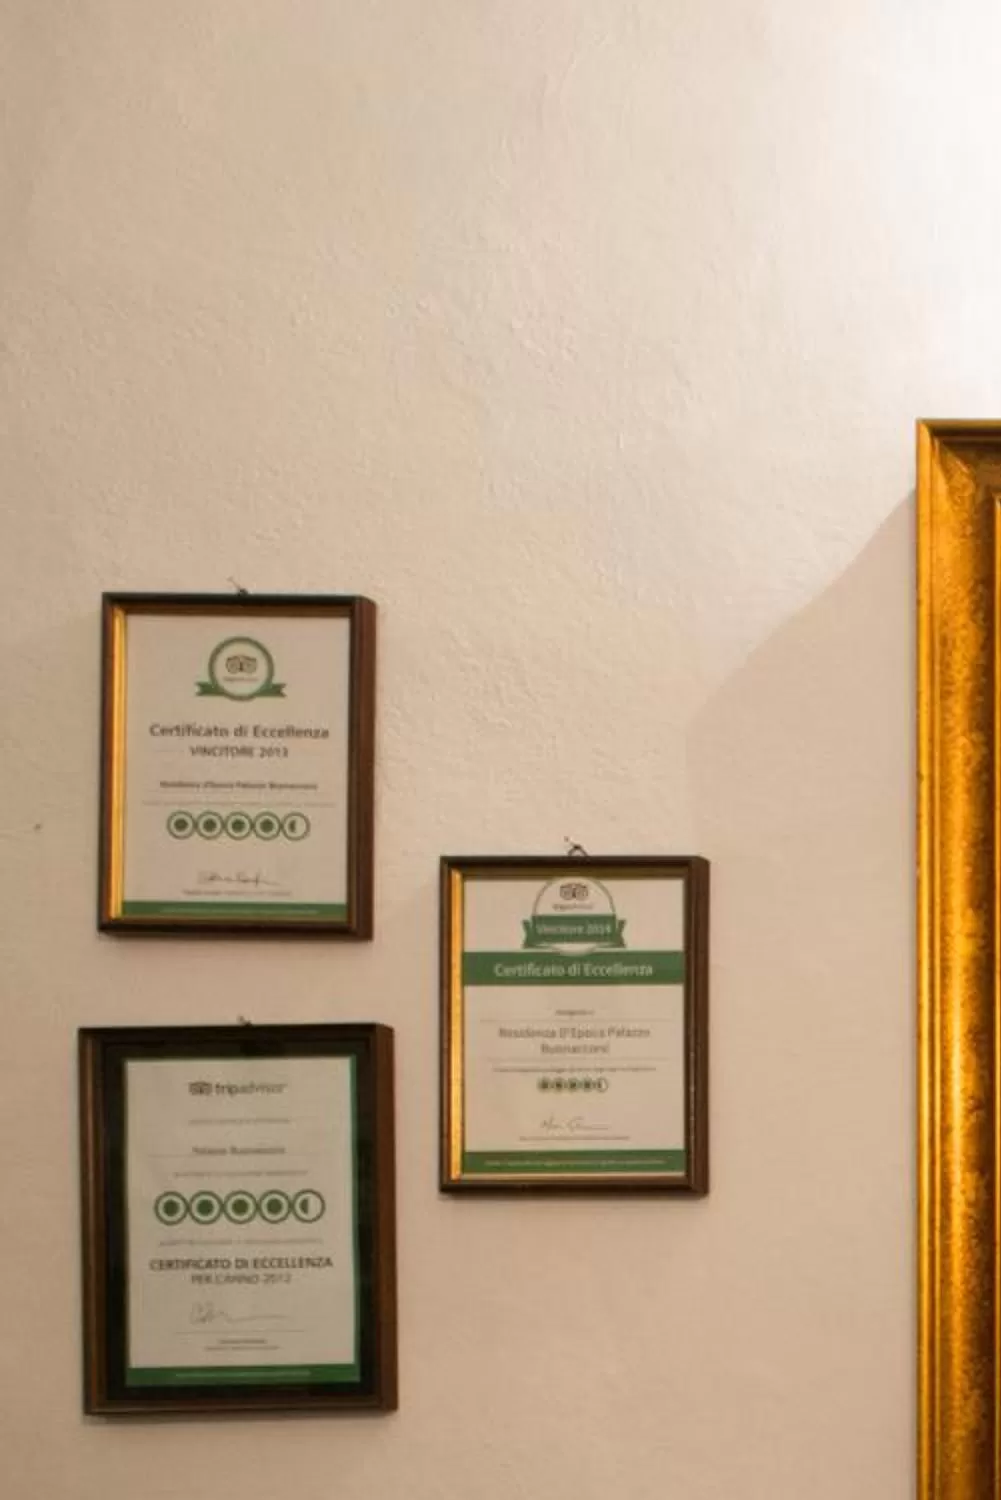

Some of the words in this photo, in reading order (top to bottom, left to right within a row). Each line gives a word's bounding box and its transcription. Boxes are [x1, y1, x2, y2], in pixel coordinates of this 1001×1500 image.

[149, 723, 229, 738] Certificato
[233, 724, 248, 738] di
[252, 724, 330, 740] Eccellenza
[494, 962, 565, 978] Certificato
[568, 963, 581, 978] di
[583, 963, 654, 978] Eccellenza
[149, 1258, 231, 1272] CERTIFICATO
[234, 1258, 249, 1270] DI
[252, 1256, 334, 1270] ECCELLENZA
